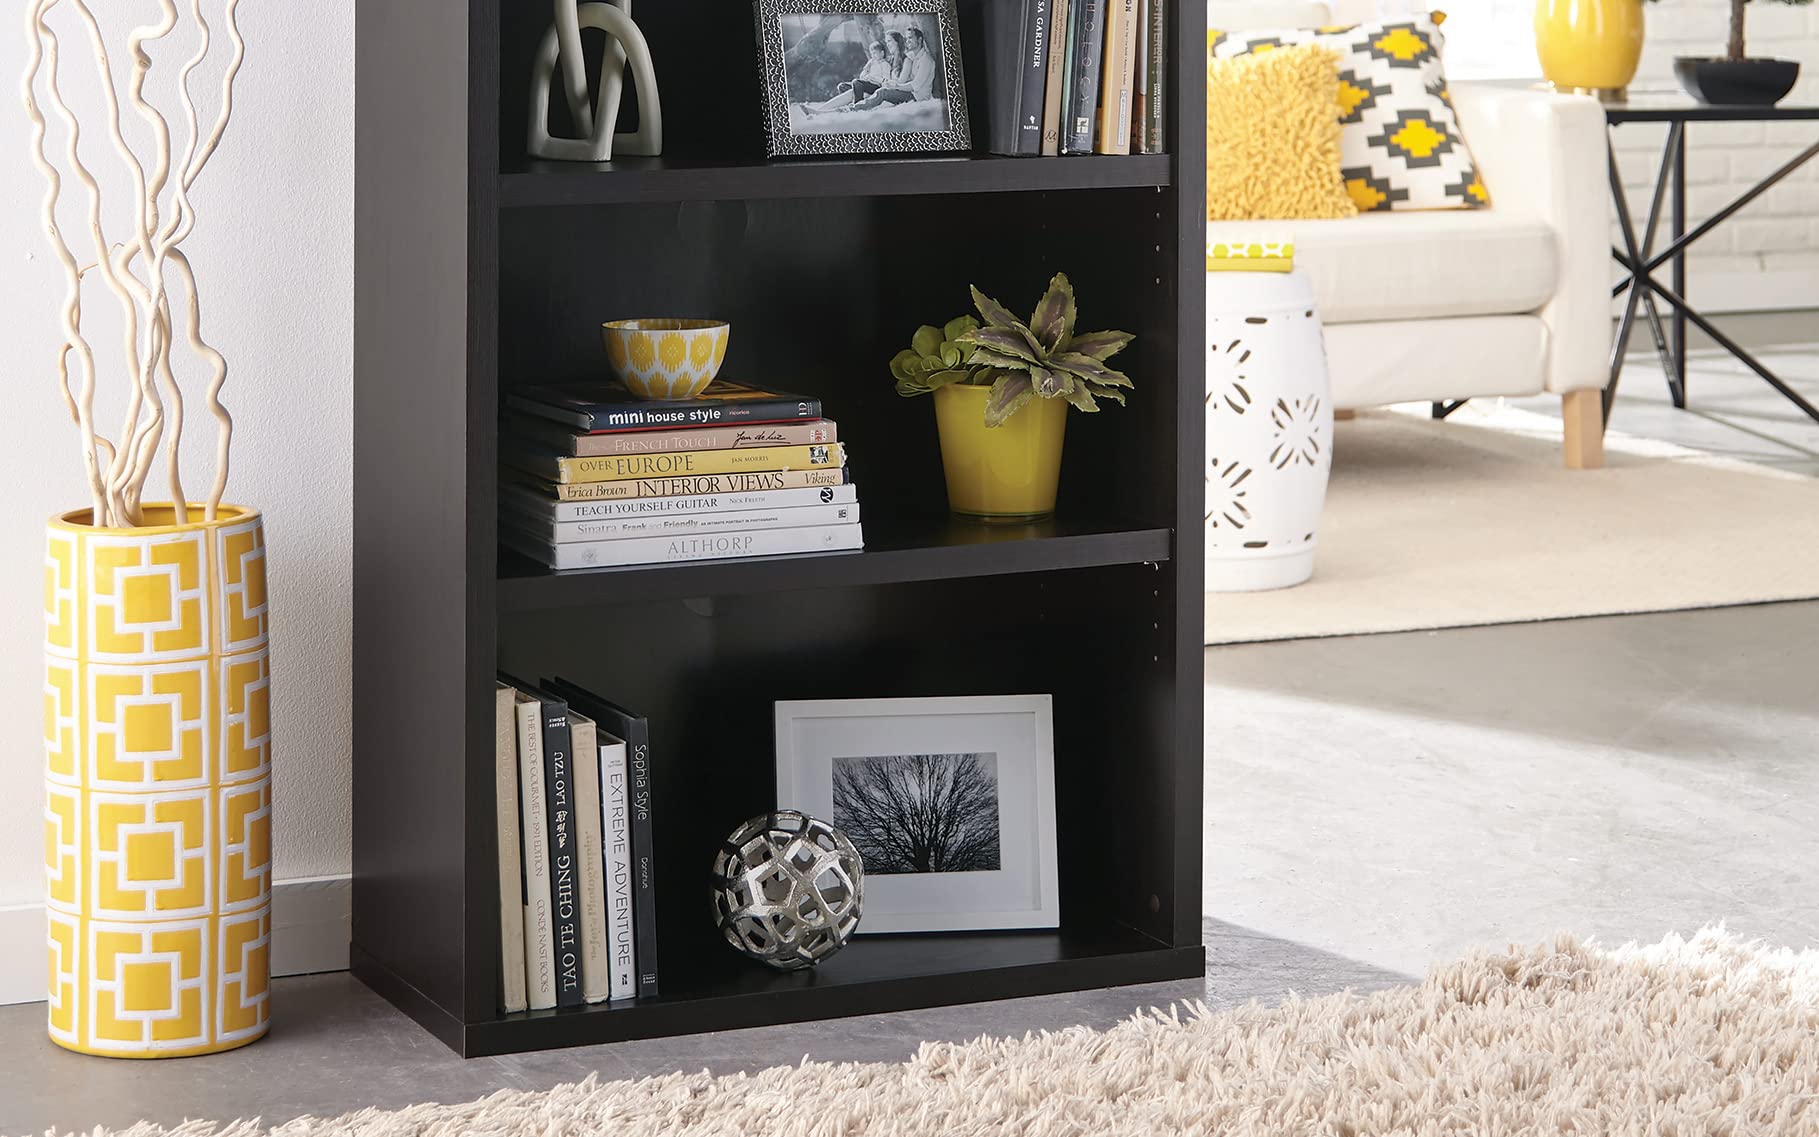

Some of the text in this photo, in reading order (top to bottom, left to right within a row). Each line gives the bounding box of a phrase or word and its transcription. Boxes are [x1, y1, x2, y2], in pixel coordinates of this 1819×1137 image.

[1033, 17, 1045, 68] GARDNER
[609, 409, 721, 425] mini house style
[615, 438, 669, 452] FRENCH
[672, 435, 718, 449] TOUCH
[580, 454, 693, 475] OVER EUROPE
[567, 472, 836, 498] Erica Brown INTERIOR VIEWS Viking
[574, 498, 719, 516] TEACH YOURSELF GUITAR
[577, 523, 617, 535] Sinatra
[622, 522, 647, 532] Frank
[663, 519, 698, 529] Friendly
[668, 536, 753, 555] ALTHORP
[528, 713, 536, 731] THE
[529, 733, 537, 751] BEST
[530, 753, 538, 765] OF
[554, 752, 564, 778] TZU
[530, 767, 540, 815] GOURMET
[556, 780, 566, 805] LAO
[634, 744, 648, 820] Sophia Style
[611, 773, 625, 854] EXTREME
[534, 839, 543, 877] EDITION
[557, 855, 573, 919] CHING
[615, 861, 630, 966] ADVENTURE
[539, 934, 548, 961] NAST
[560, 924, 575, 948] TE
[540, 962, 550, 993] BOOKS
[562, 953, 577, 991] TAO
